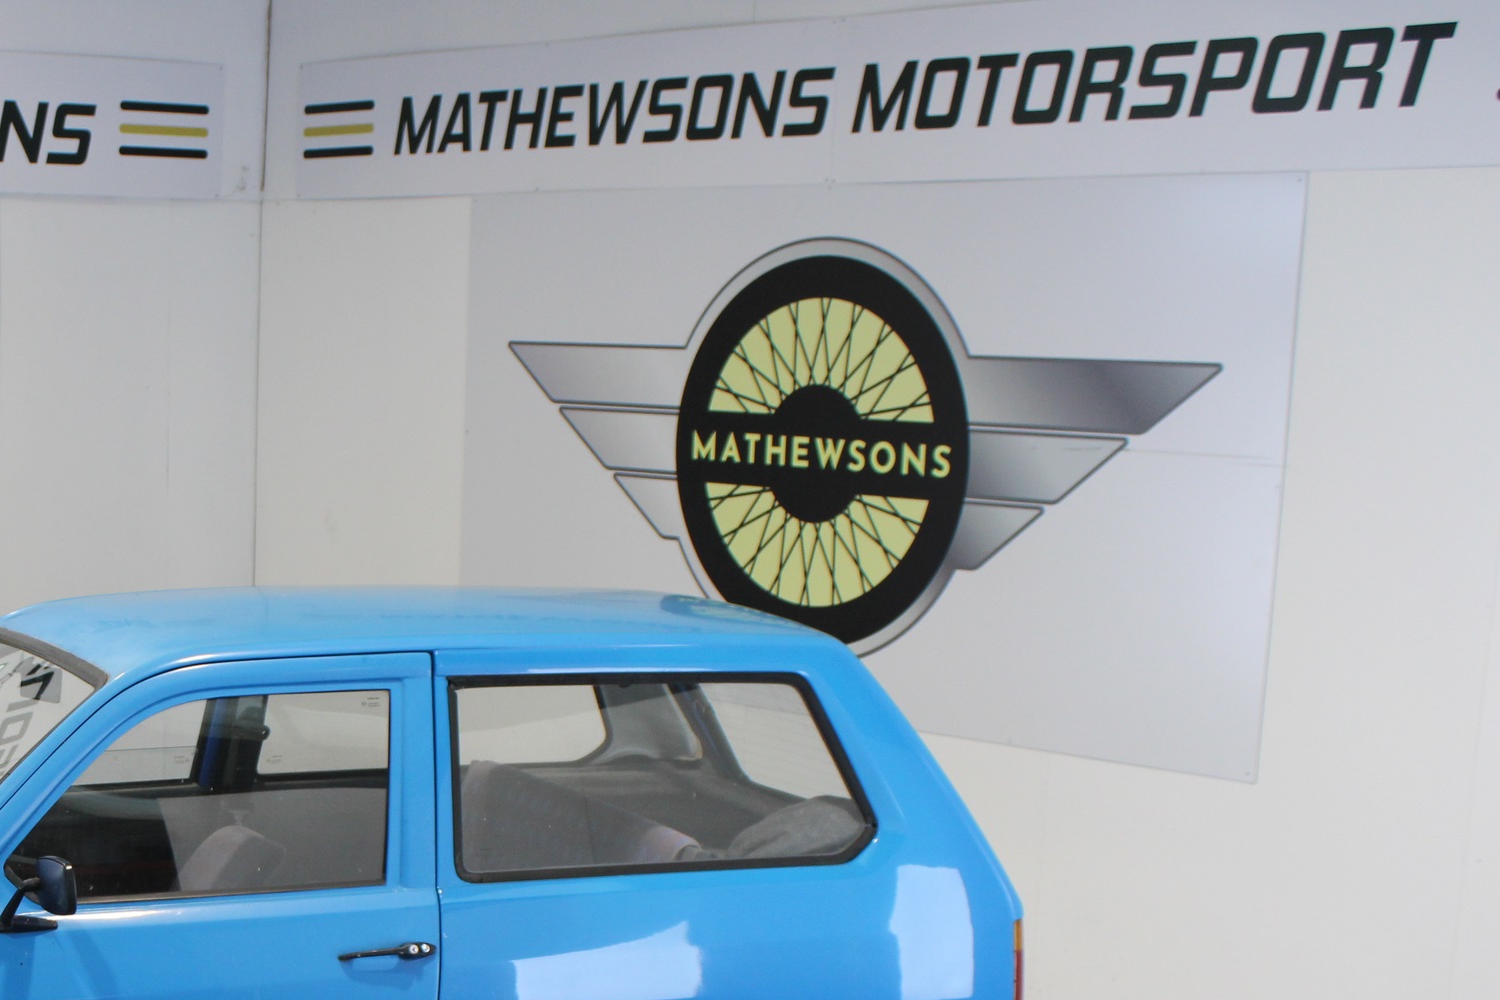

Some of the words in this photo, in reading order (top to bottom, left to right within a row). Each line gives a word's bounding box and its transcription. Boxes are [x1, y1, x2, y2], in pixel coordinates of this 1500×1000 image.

[393, 66, 836, 156] MATHEWSONS
[851, 21, 1459, 134] MOTORSPORT
[691, 430, 952, 479] MATHEWSONS
